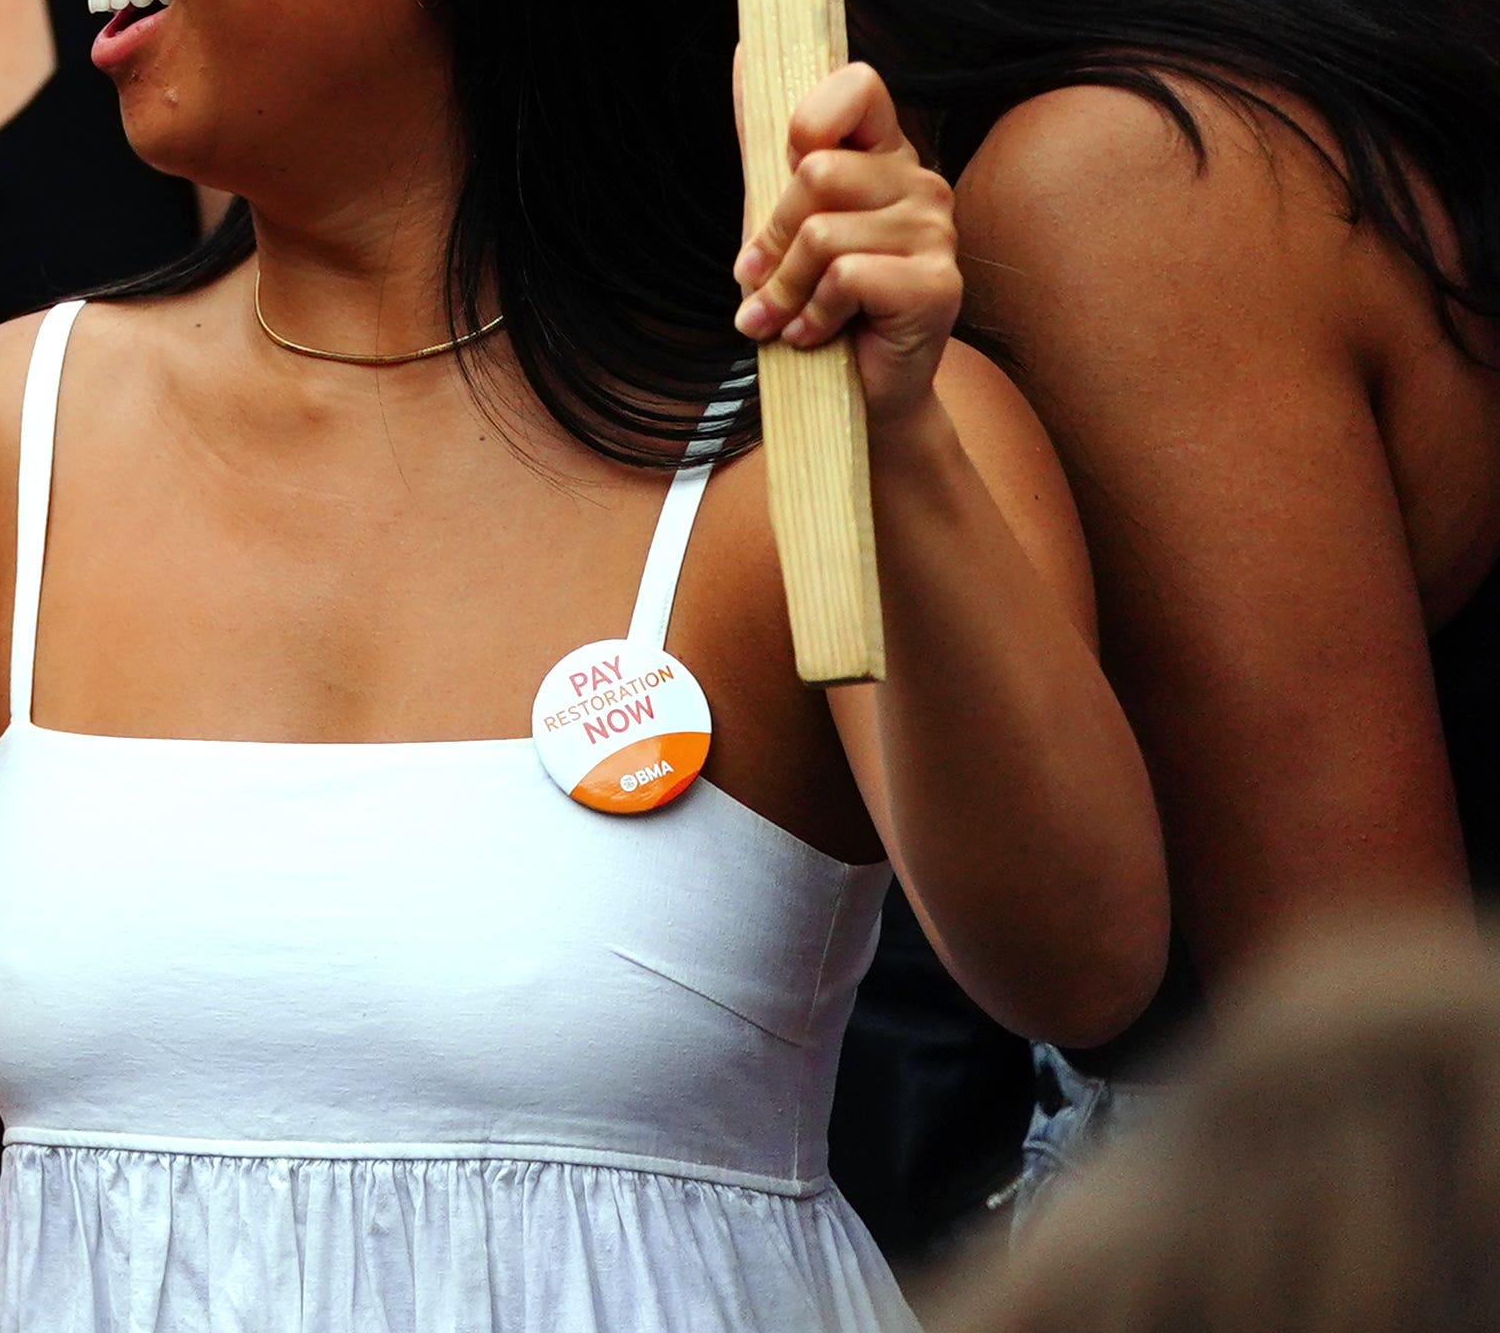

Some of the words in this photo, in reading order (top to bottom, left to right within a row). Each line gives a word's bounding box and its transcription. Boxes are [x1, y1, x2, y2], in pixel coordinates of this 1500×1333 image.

[543, 665, 674, 732] RESTORATION
[569, 655, 623, 697] PAY
[583, 695, 655, 745] NOW
[636, 760, 674, 785] BMA
